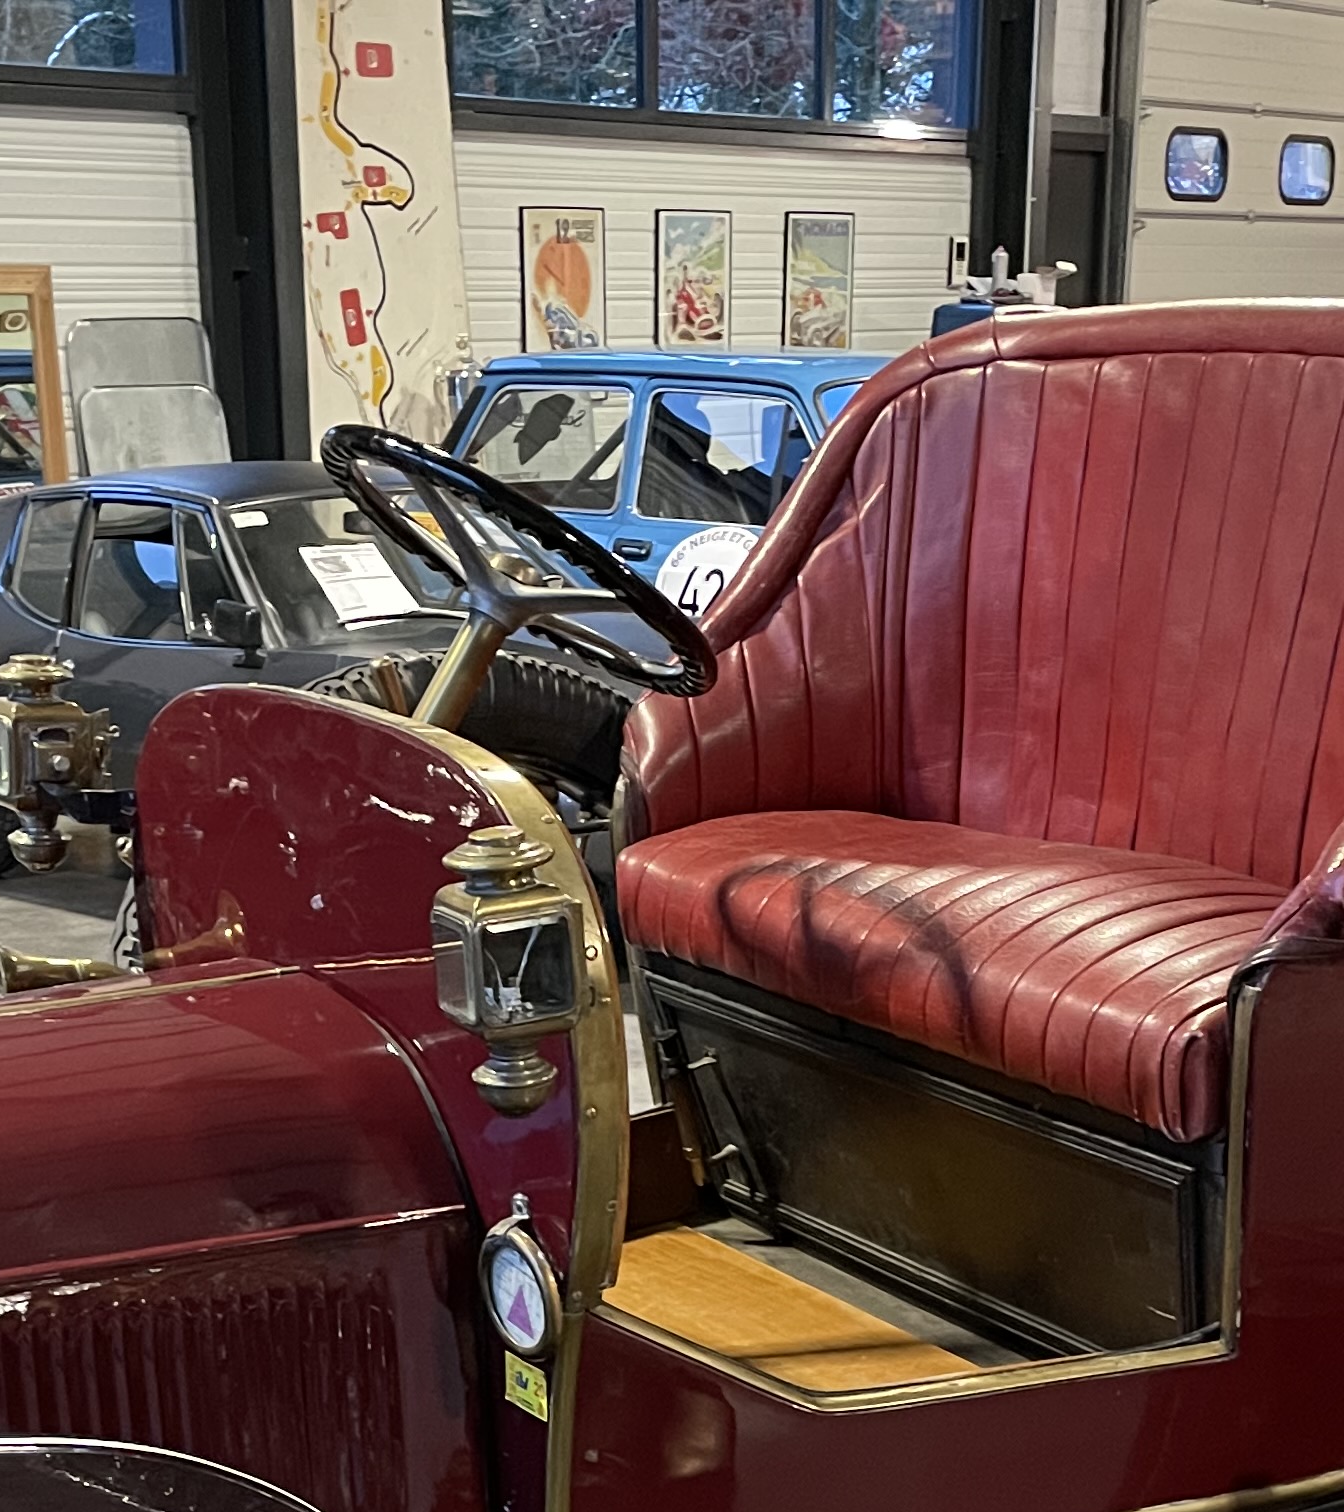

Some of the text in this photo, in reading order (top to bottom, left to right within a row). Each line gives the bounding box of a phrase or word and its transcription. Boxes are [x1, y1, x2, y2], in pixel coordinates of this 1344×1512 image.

[689, 531, 728, 550] NEIGE
[729, 531, 745, 543] ET
[677, 566, 725, 616] 42
